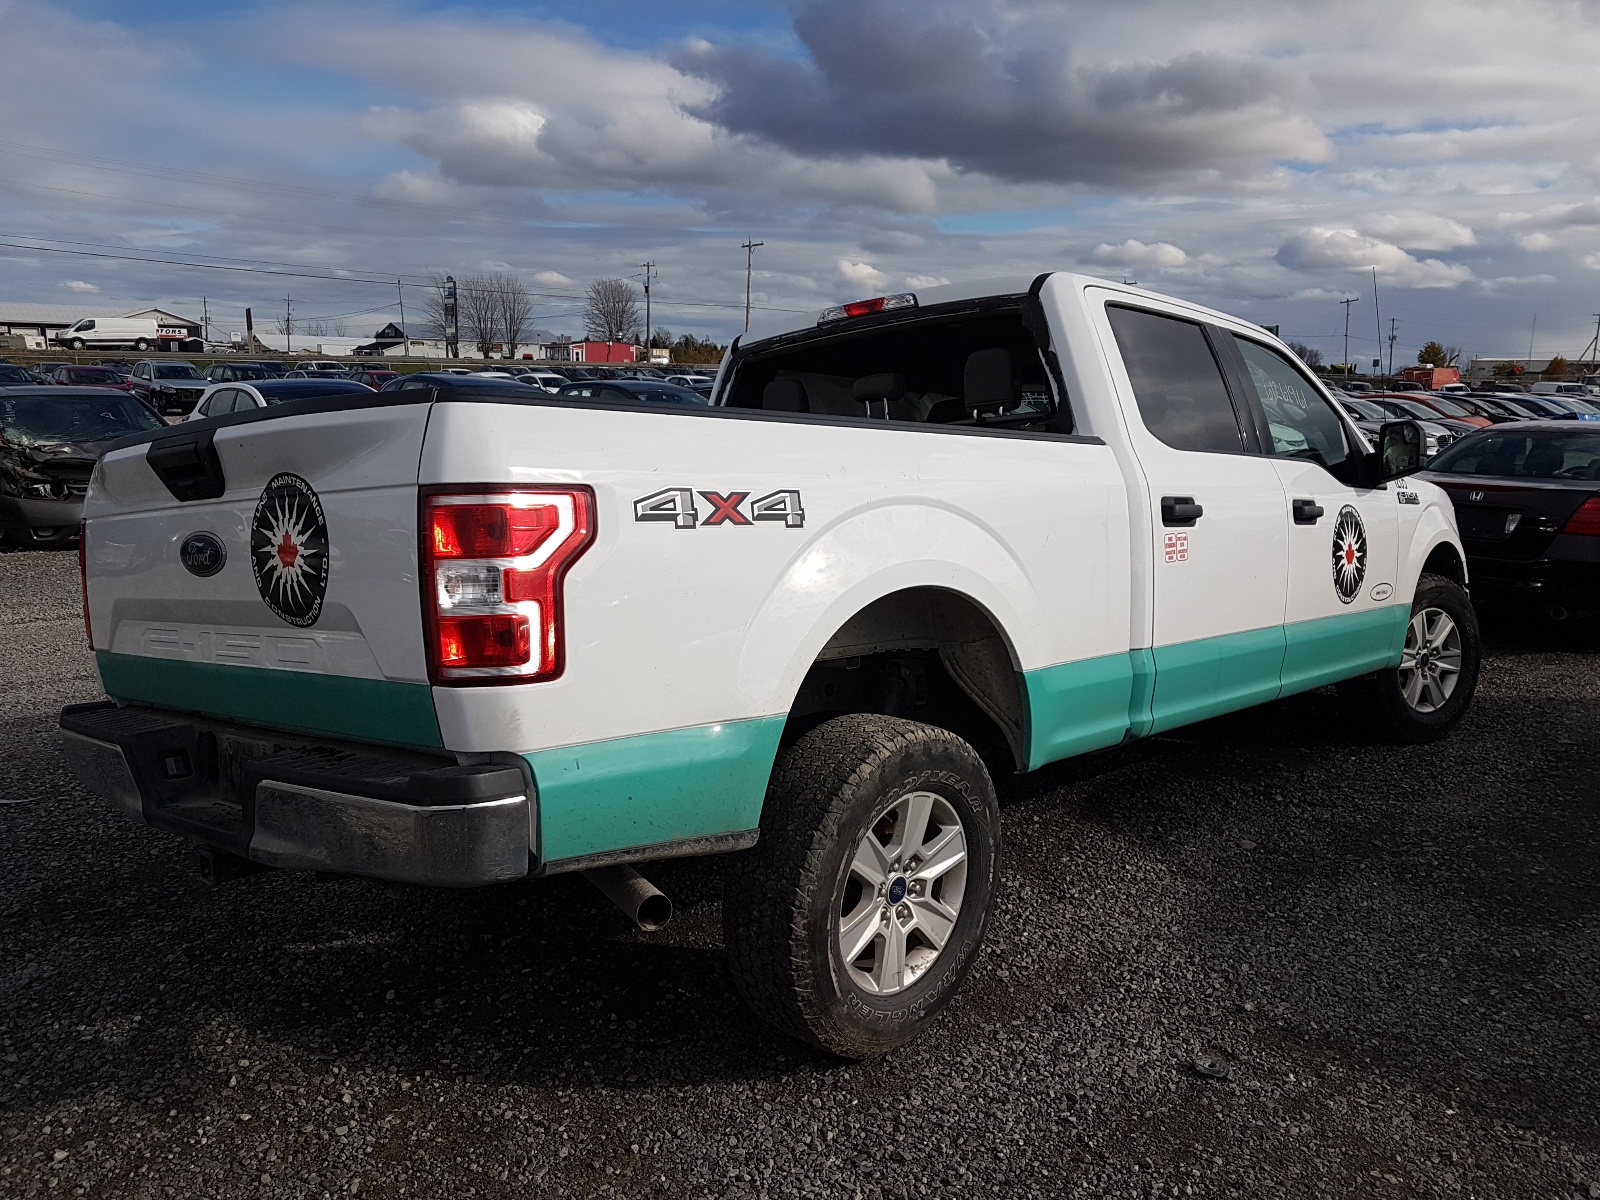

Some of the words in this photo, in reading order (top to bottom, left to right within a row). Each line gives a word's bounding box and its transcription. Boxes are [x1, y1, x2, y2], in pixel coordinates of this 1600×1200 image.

[271, 475, 325, 526] MAINTENANCE
[251, 555, 263, 588] AND
[264, 595, 321, 626] CONSTRUCTION
